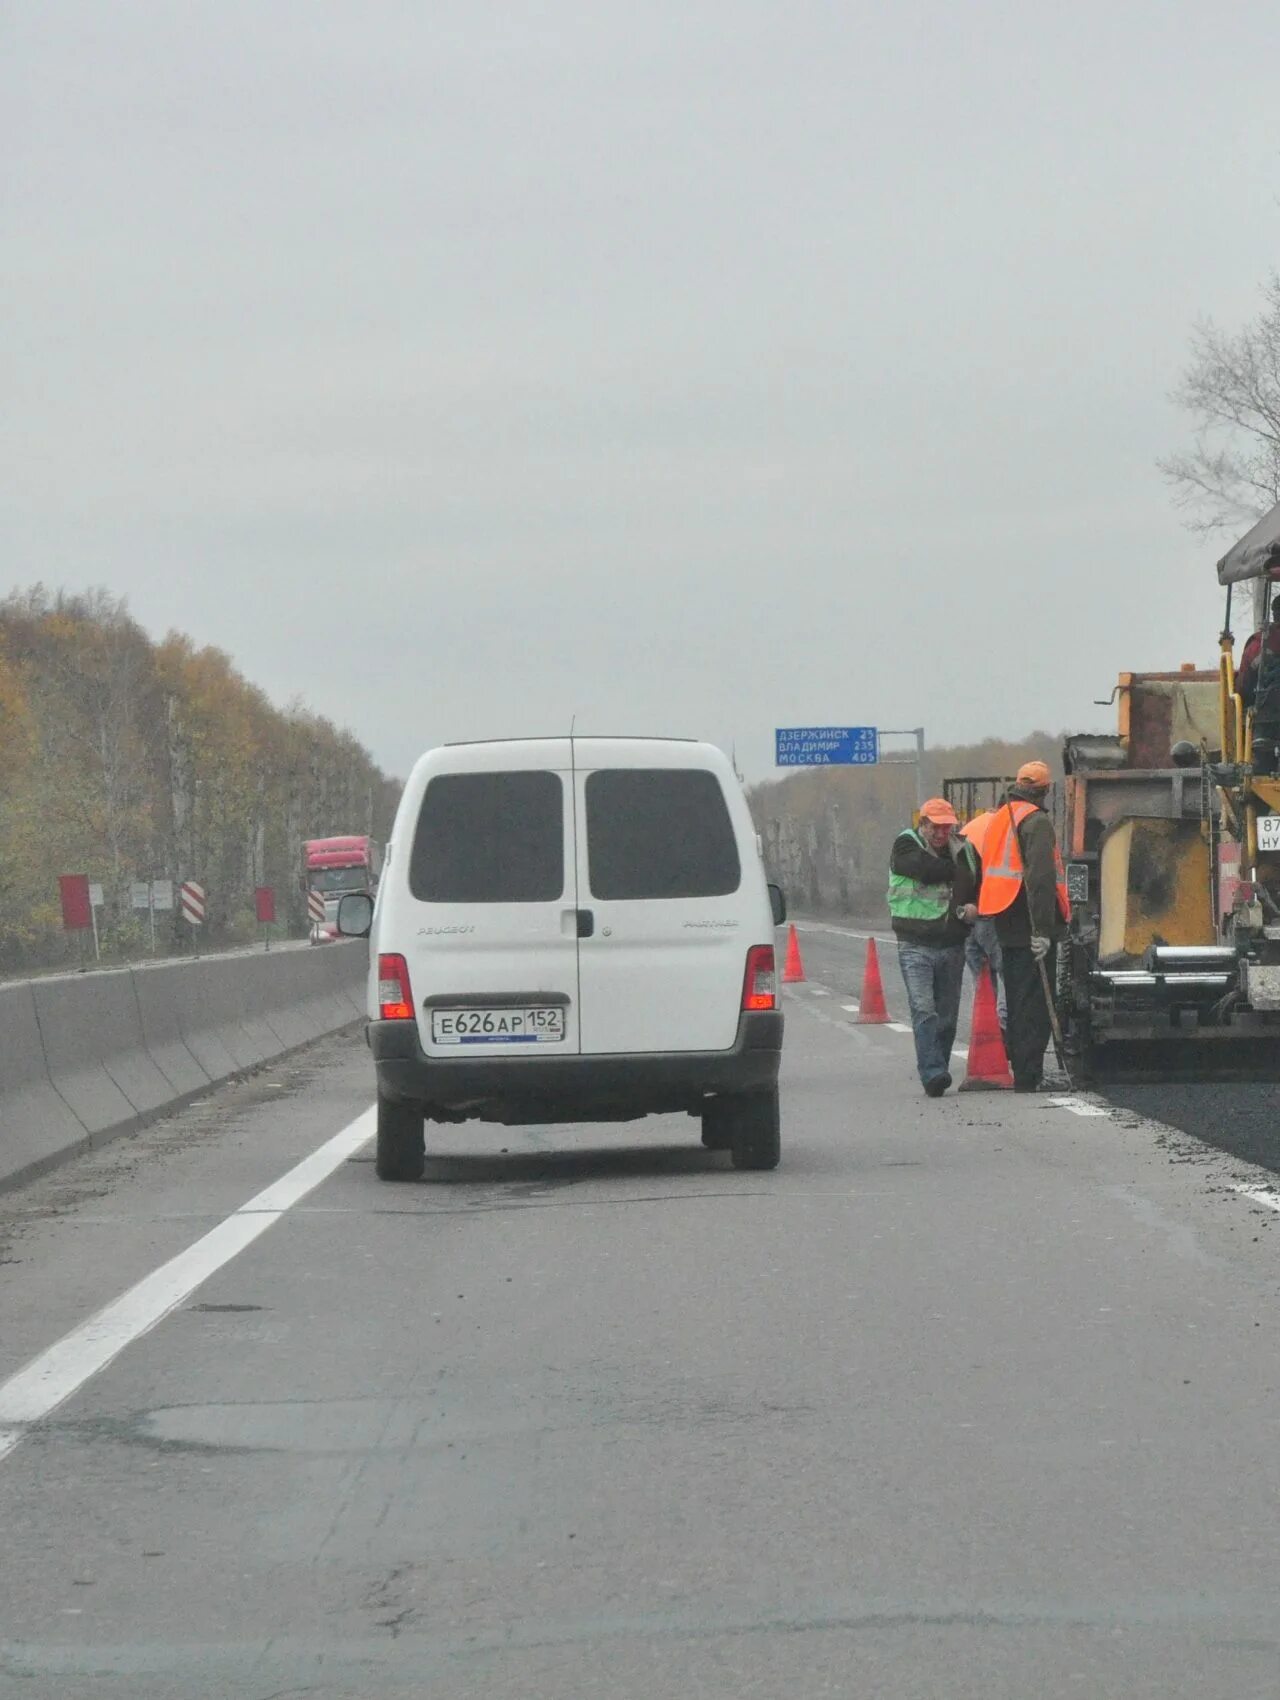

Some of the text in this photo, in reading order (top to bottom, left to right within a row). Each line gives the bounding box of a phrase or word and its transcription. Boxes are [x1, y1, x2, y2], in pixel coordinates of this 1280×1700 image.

[779, 730, 849, 741] ДЗЕРЖИНСК
[779, 741, 874, 752] ВЛАДИМИР 235
[779, 753, 875, 763] МОСКВА 405
[527, 1011, 557, 1026] 152
